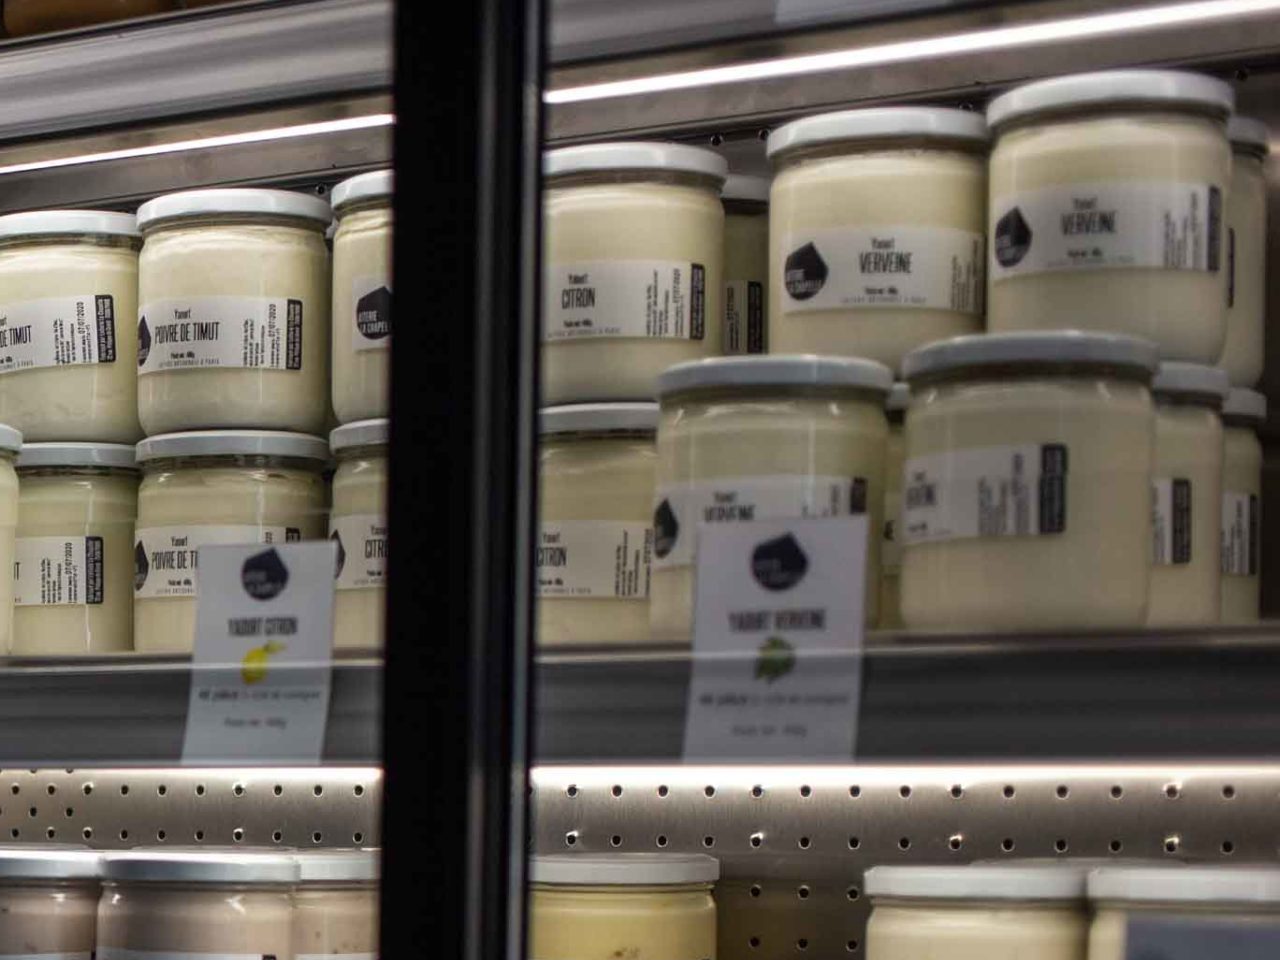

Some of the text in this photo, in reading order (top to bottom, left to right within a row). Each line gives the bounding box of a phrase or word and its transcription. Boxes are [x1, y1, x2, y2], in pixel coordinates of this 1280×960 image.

[860, 252, 912, 274] VERVEINE
[561, 288, 596, 311] CITRON
[9, 325, 32, 346] TIMUT
[180, 322, 190, 342] DE
[192, 321, 220, 341] TIMUT
[177, 551, 189, 570] DE
